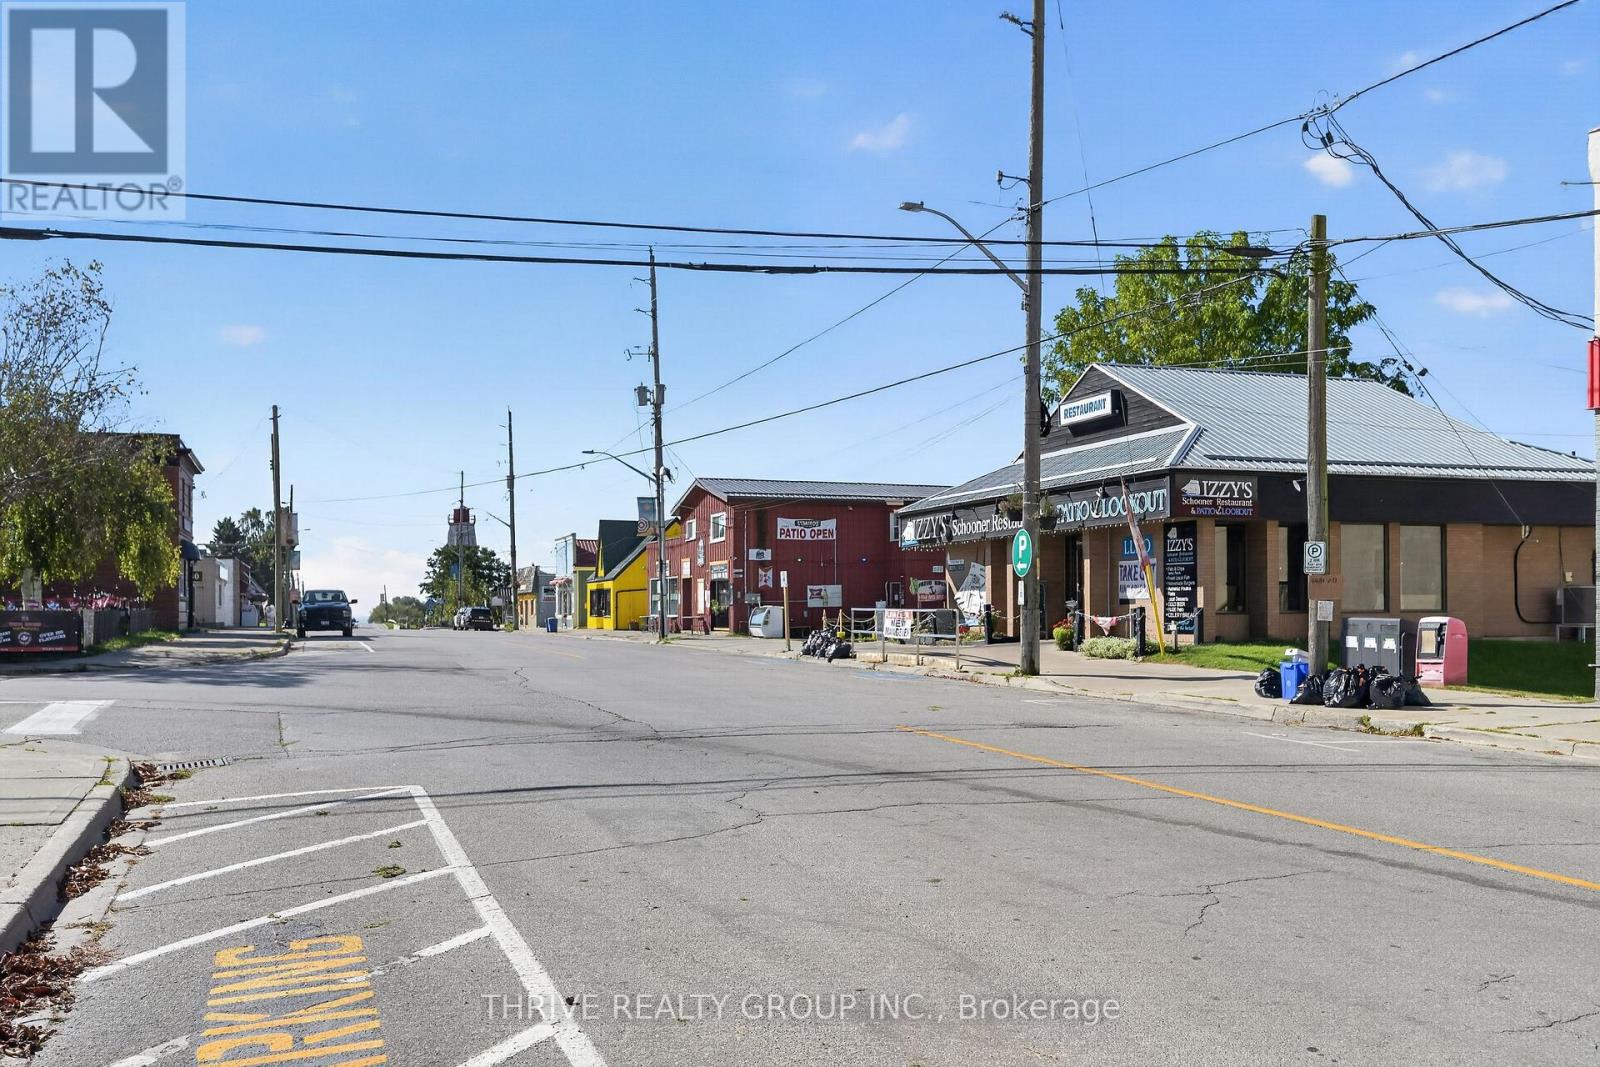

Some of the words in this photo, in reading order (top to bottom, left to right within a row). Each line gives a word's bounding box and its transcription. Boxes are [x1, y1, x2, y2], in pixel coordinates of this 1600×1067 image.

[1063, 397, 1107, 419] RESTAURANT
[1202, 480, 1253, 498] IZZY'S
[1182, 496, 1213, 506] Schooner
[1217, 497, 1253, 507] Restaurant
[1196, 507, 1216, 515] PATIO
[1221, 507, 1254, 515] LOOKOUT
[779, 528, 807, 539] PATIO
[809, 528, 834, 539] OPEN
[912, 514, 948, 541] IZZY'S
[952, 517, 991, 536] Schooner
[1167, 537, 1194, 552] IZZY'S
